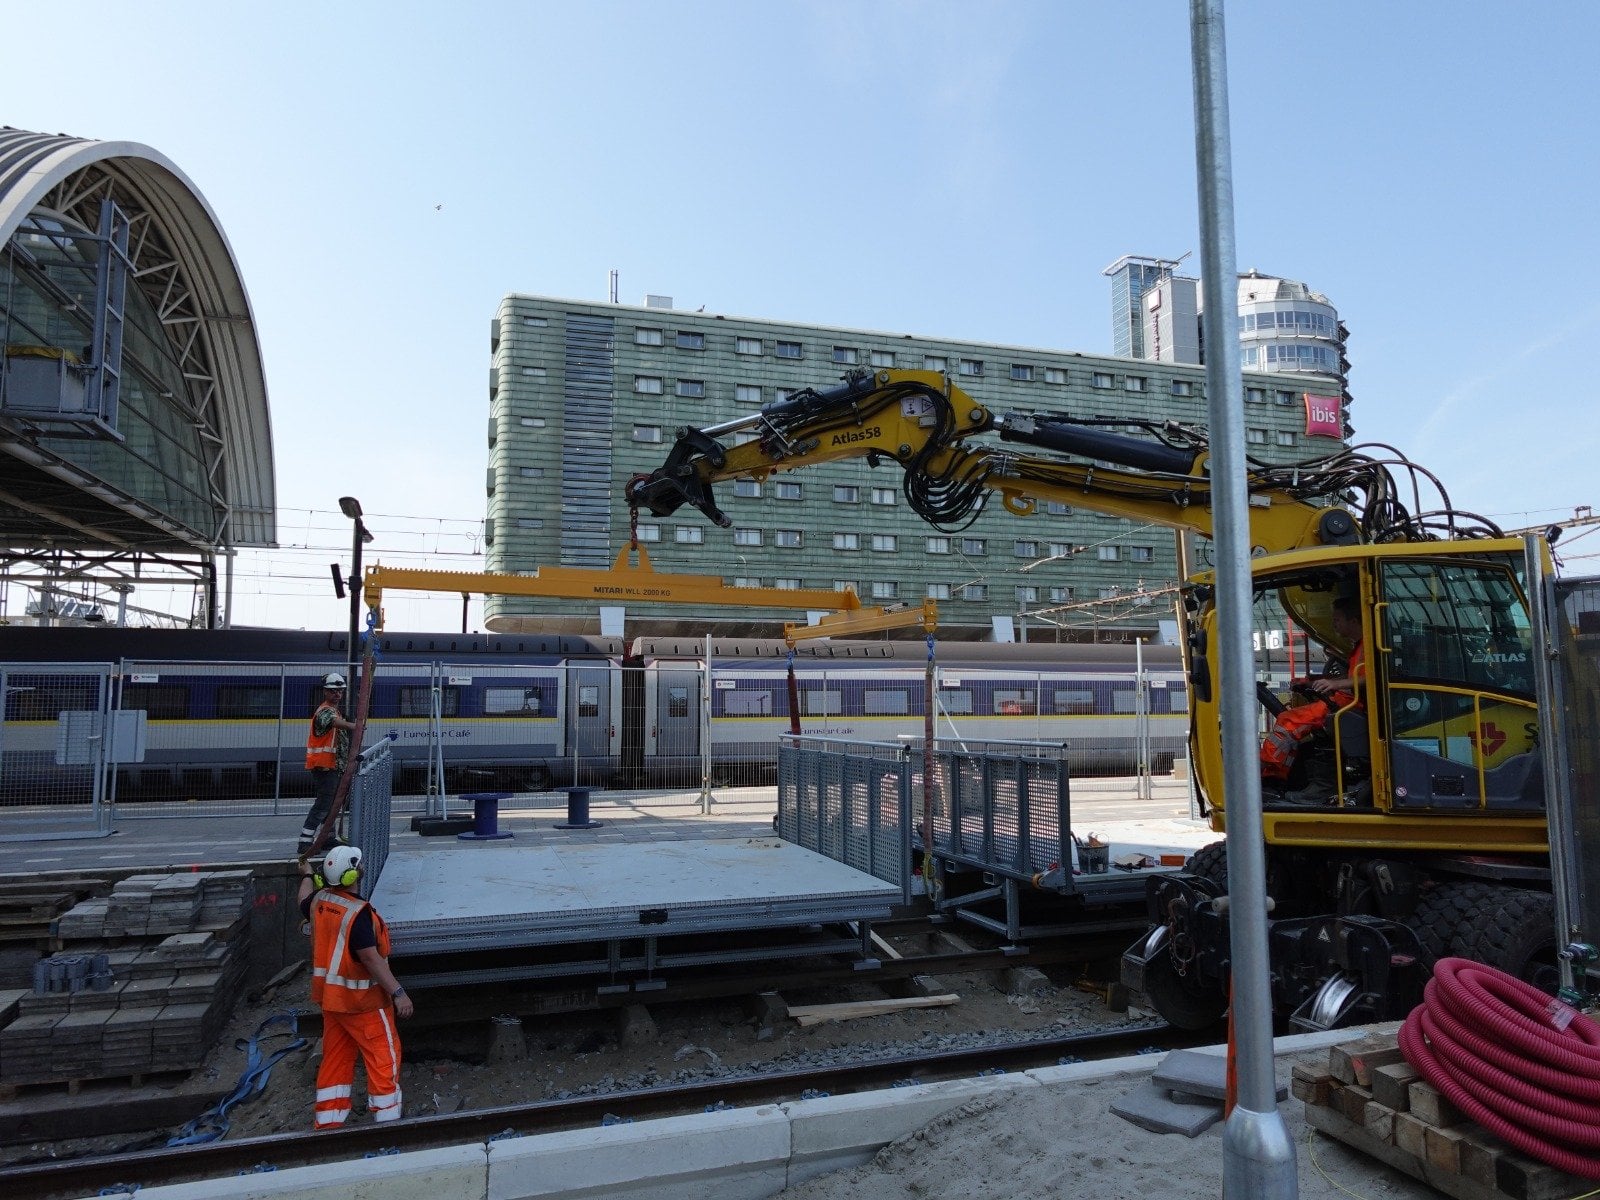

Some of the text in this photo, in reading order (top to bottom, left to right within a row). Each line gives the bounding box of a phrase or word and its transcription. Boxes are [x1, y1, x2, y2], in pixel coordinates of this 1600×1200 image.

[1312, 406, 1336, 423] ibis
[831, 426, 882, 446] Atlas58
[593, 586, 623, 594] MITARI
[1483, 652, 1527, 663] ATLAS
[448, 729, 471, 738] Café
